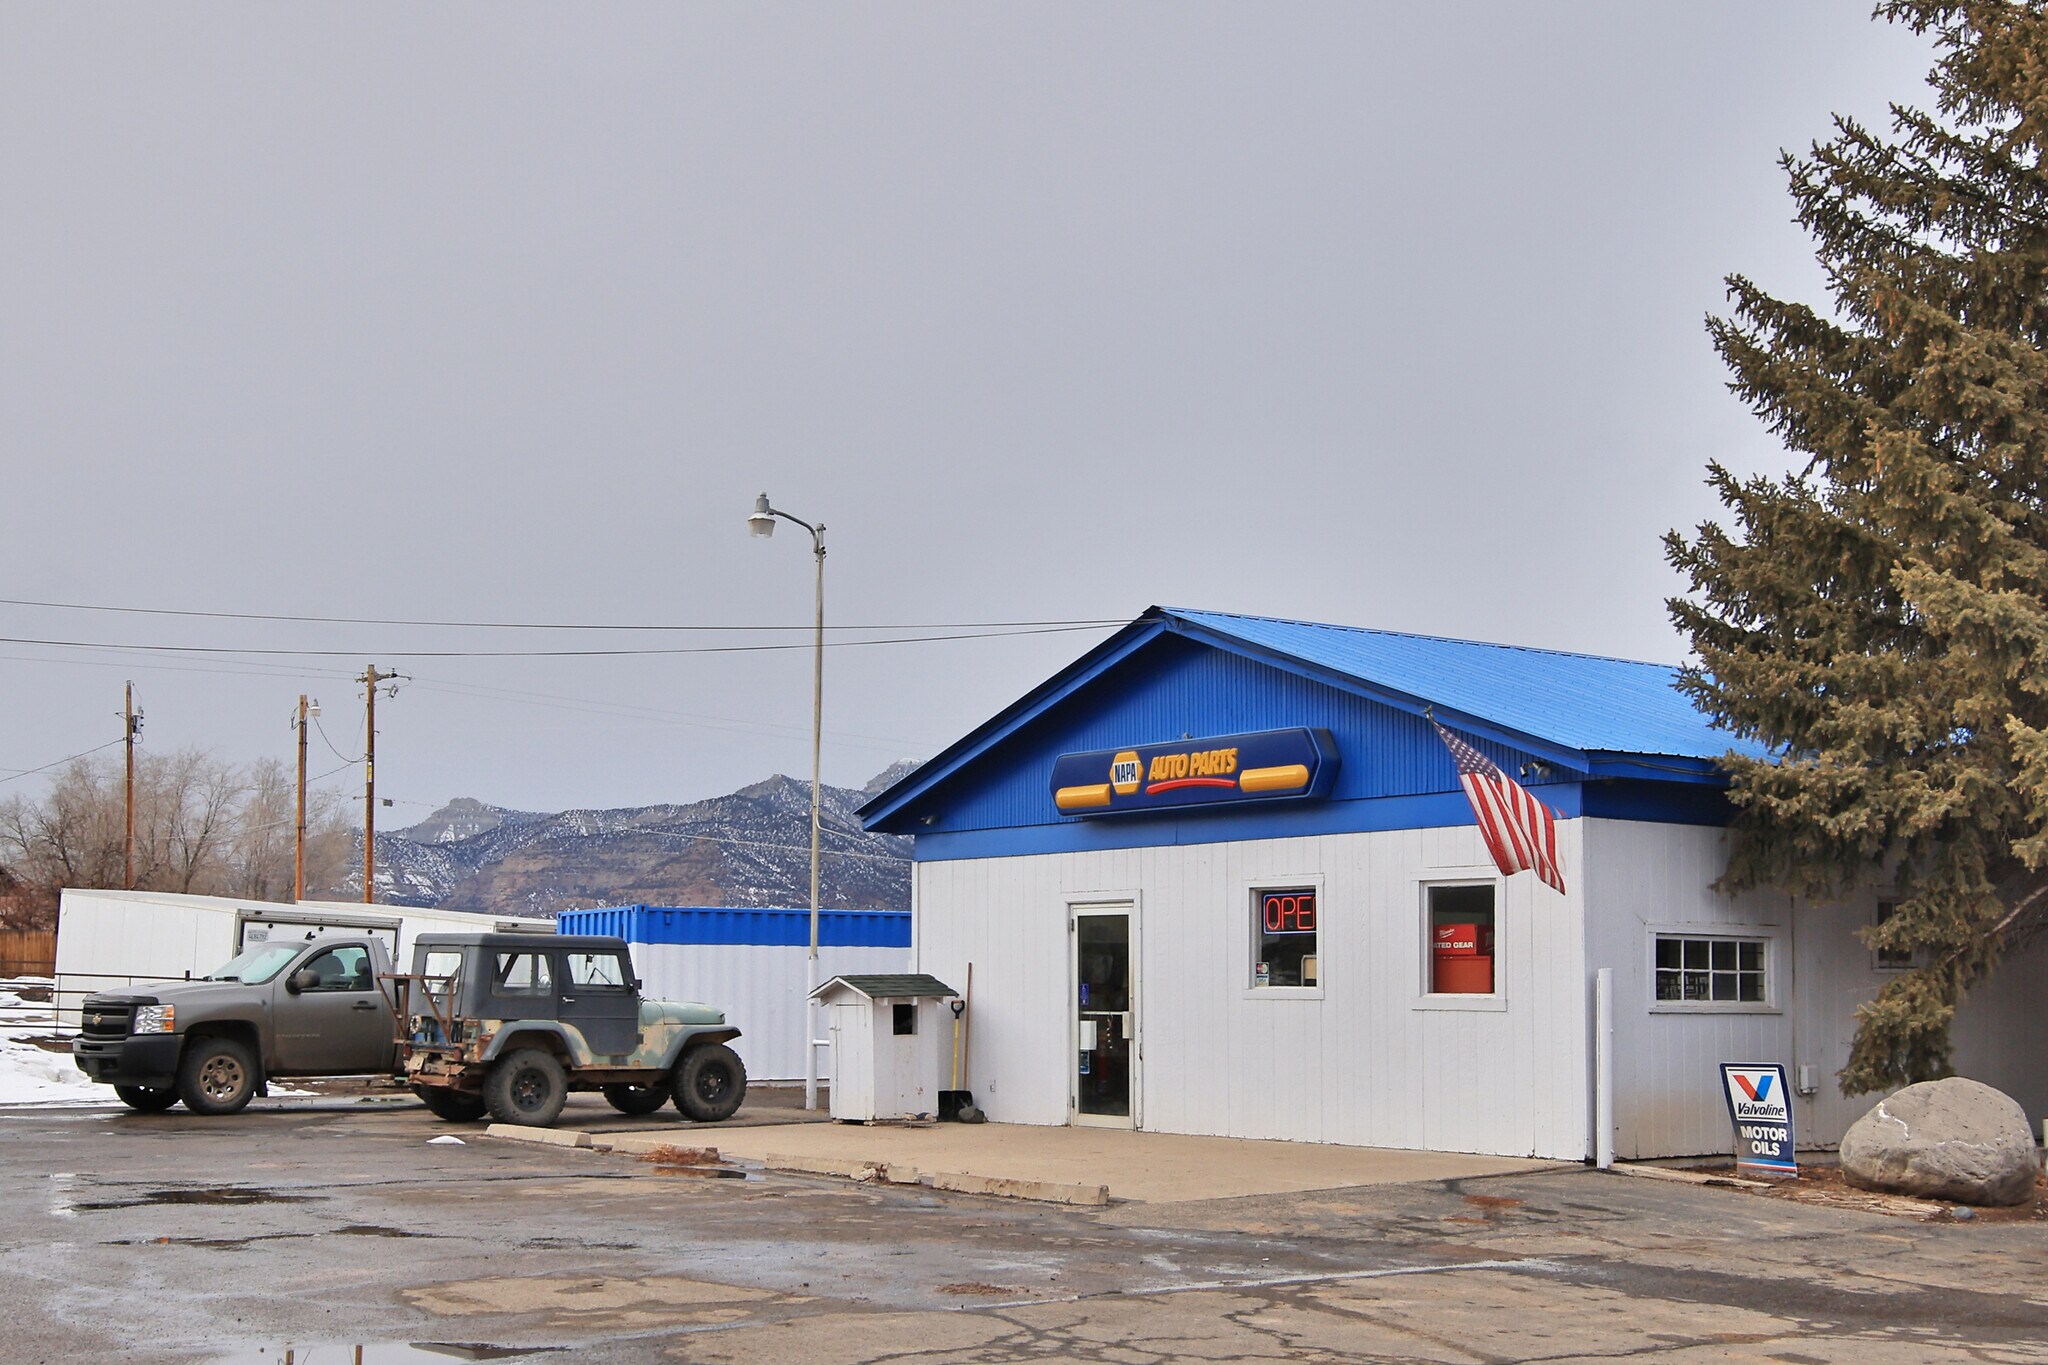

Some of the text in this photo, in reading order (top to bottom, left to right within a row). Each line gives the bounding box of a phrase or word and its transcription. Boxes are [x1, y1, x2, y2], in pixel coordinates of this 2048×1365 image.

[1114, 762, 1137, 783] NAPA
[1148, 747, 1238, 781] AUTO PARTS
[1266, 896, 1315, 930] OPE
[1453, 941, 1473, 949] GEAR
[1737, 1102, 1785, 1116] Valvoline
[1740, 1125, 1788, 1142] MOTOR
[1751, 1141, 1780, 1157] OILS
